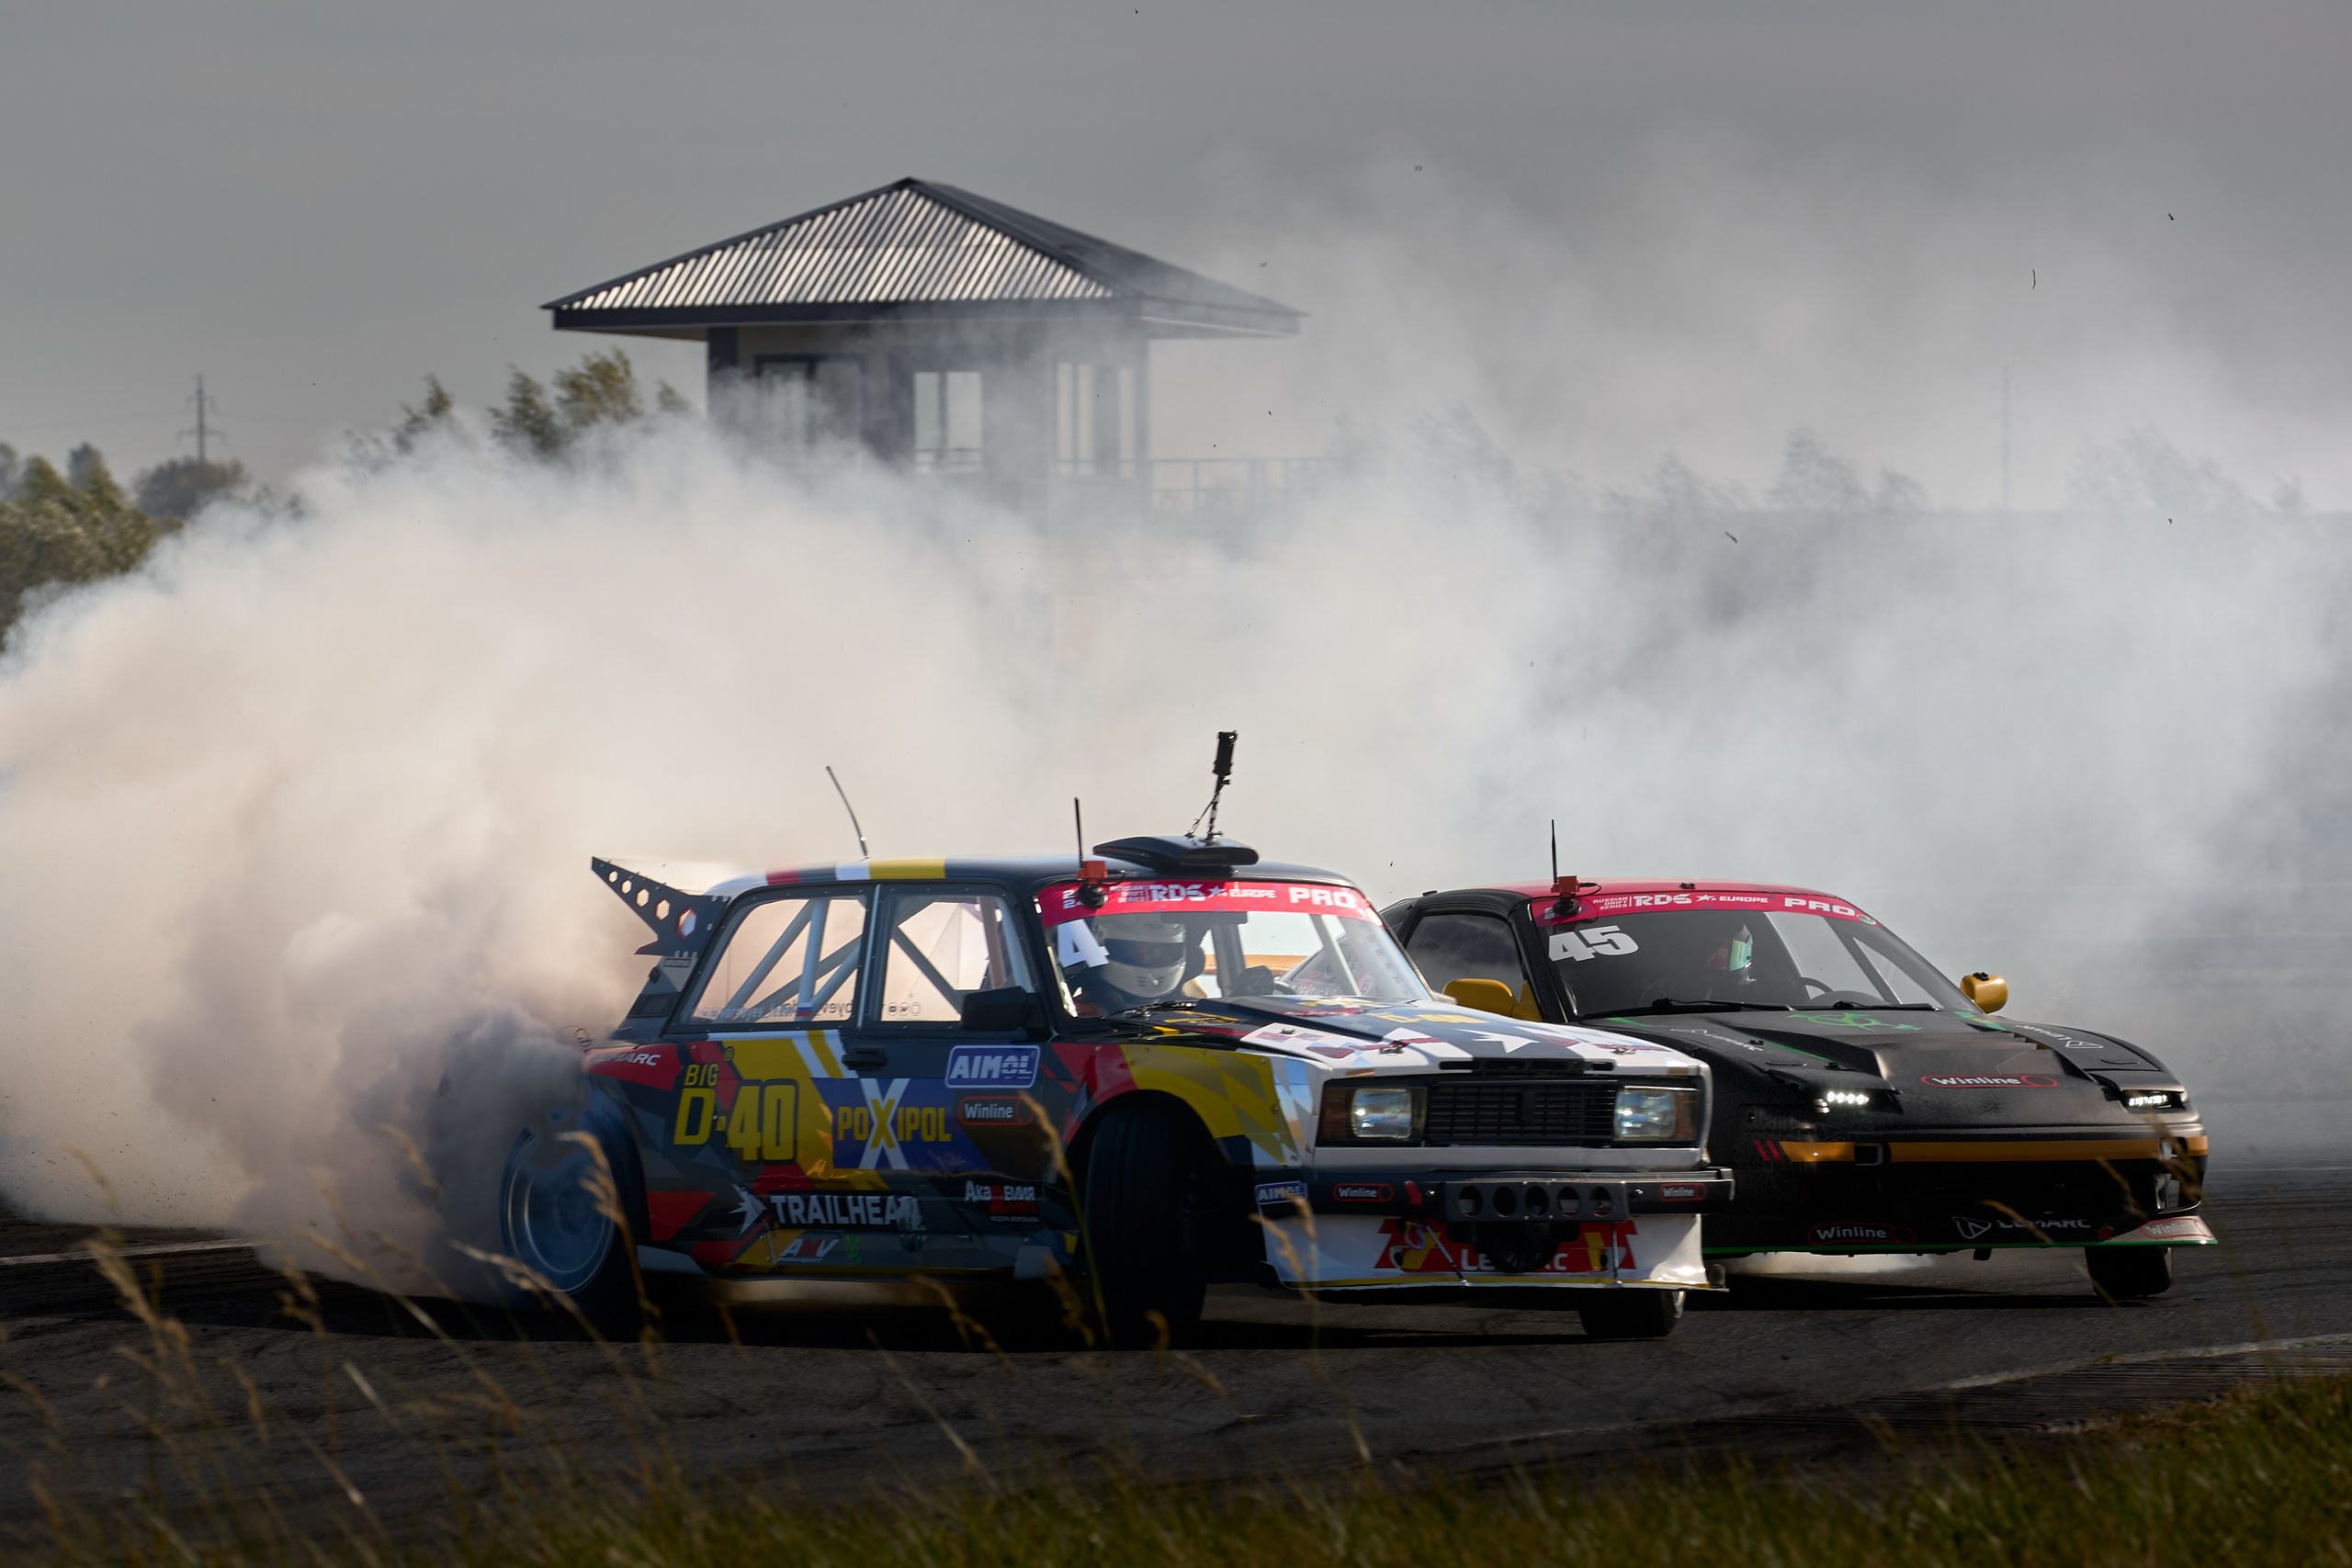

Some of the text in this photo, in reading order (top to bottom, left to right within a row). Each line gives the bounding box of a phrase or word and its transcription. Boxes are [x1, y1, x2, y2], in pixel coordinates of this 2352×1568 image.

[1149, 884, 1356, 908] RDS EUROPE PRO
[1633, 894, 1692, 907] RDS
[1784, 897, 1856, 917] PRO
[1057, 919, 1110, 968] 4
[1548, 925, 1639, 962] 45
[684, 1063, 719, 1087] BIG
[949, 1055, 1033, 1079] AIMOL
[1931, 1076, 2021, 1086] Winline
[673, 1084, 797, 1161] D-40
[964, 1102, 1014, 1119] Winline
[837, 1098, 952, 1149] POXIPOL
[1338, 1187, 1378, 1198] Winline
[1662, 1187, 1695, 1198] Winline
[770, 1195, 922, 1225] TRAILHEA
[1815, 1225, 1888, 1240] Winline
[780, 1238, 840, 1258] ANV
